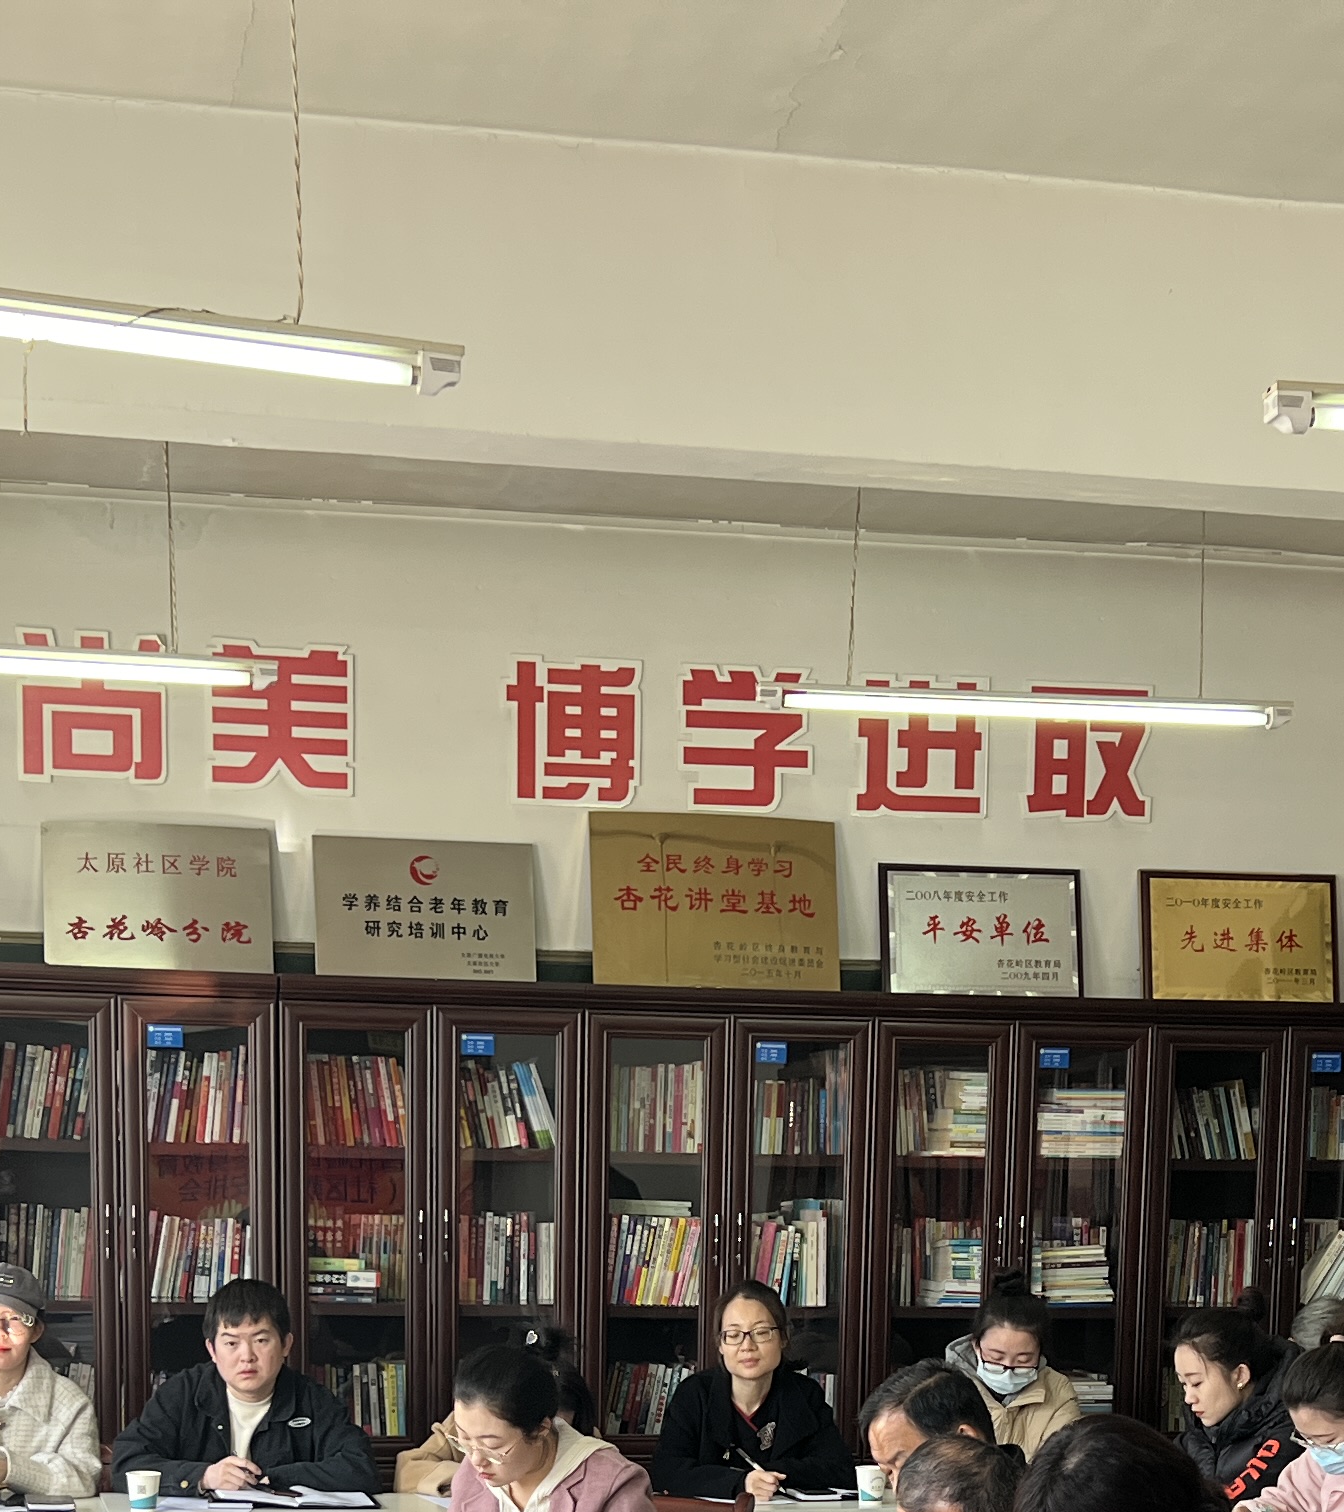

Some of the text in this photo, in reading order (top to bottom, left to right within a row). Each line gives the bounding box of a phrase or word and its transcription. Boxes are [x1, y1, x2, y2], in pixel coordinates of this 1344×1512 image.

[504, 654, 1155, 822] 博学进取
[76, 851, 238, 878] 太原社区学院
[637, 852, 793, 879] 全民终身学习
[342, 892, 509, 917] 学养结合老年教育
[613, 885, 816, 919] 杏花讲堂基地
[65, 915, 252, 944] 杏花岭分院
[364, 920, 489, 941] 研究培训中心
[922, 913, 1050, 947] 平安单位
[1180, 925, 1303, 954] 先进集体
[997, 958, 1061, 969] 杏花岭区教育局
